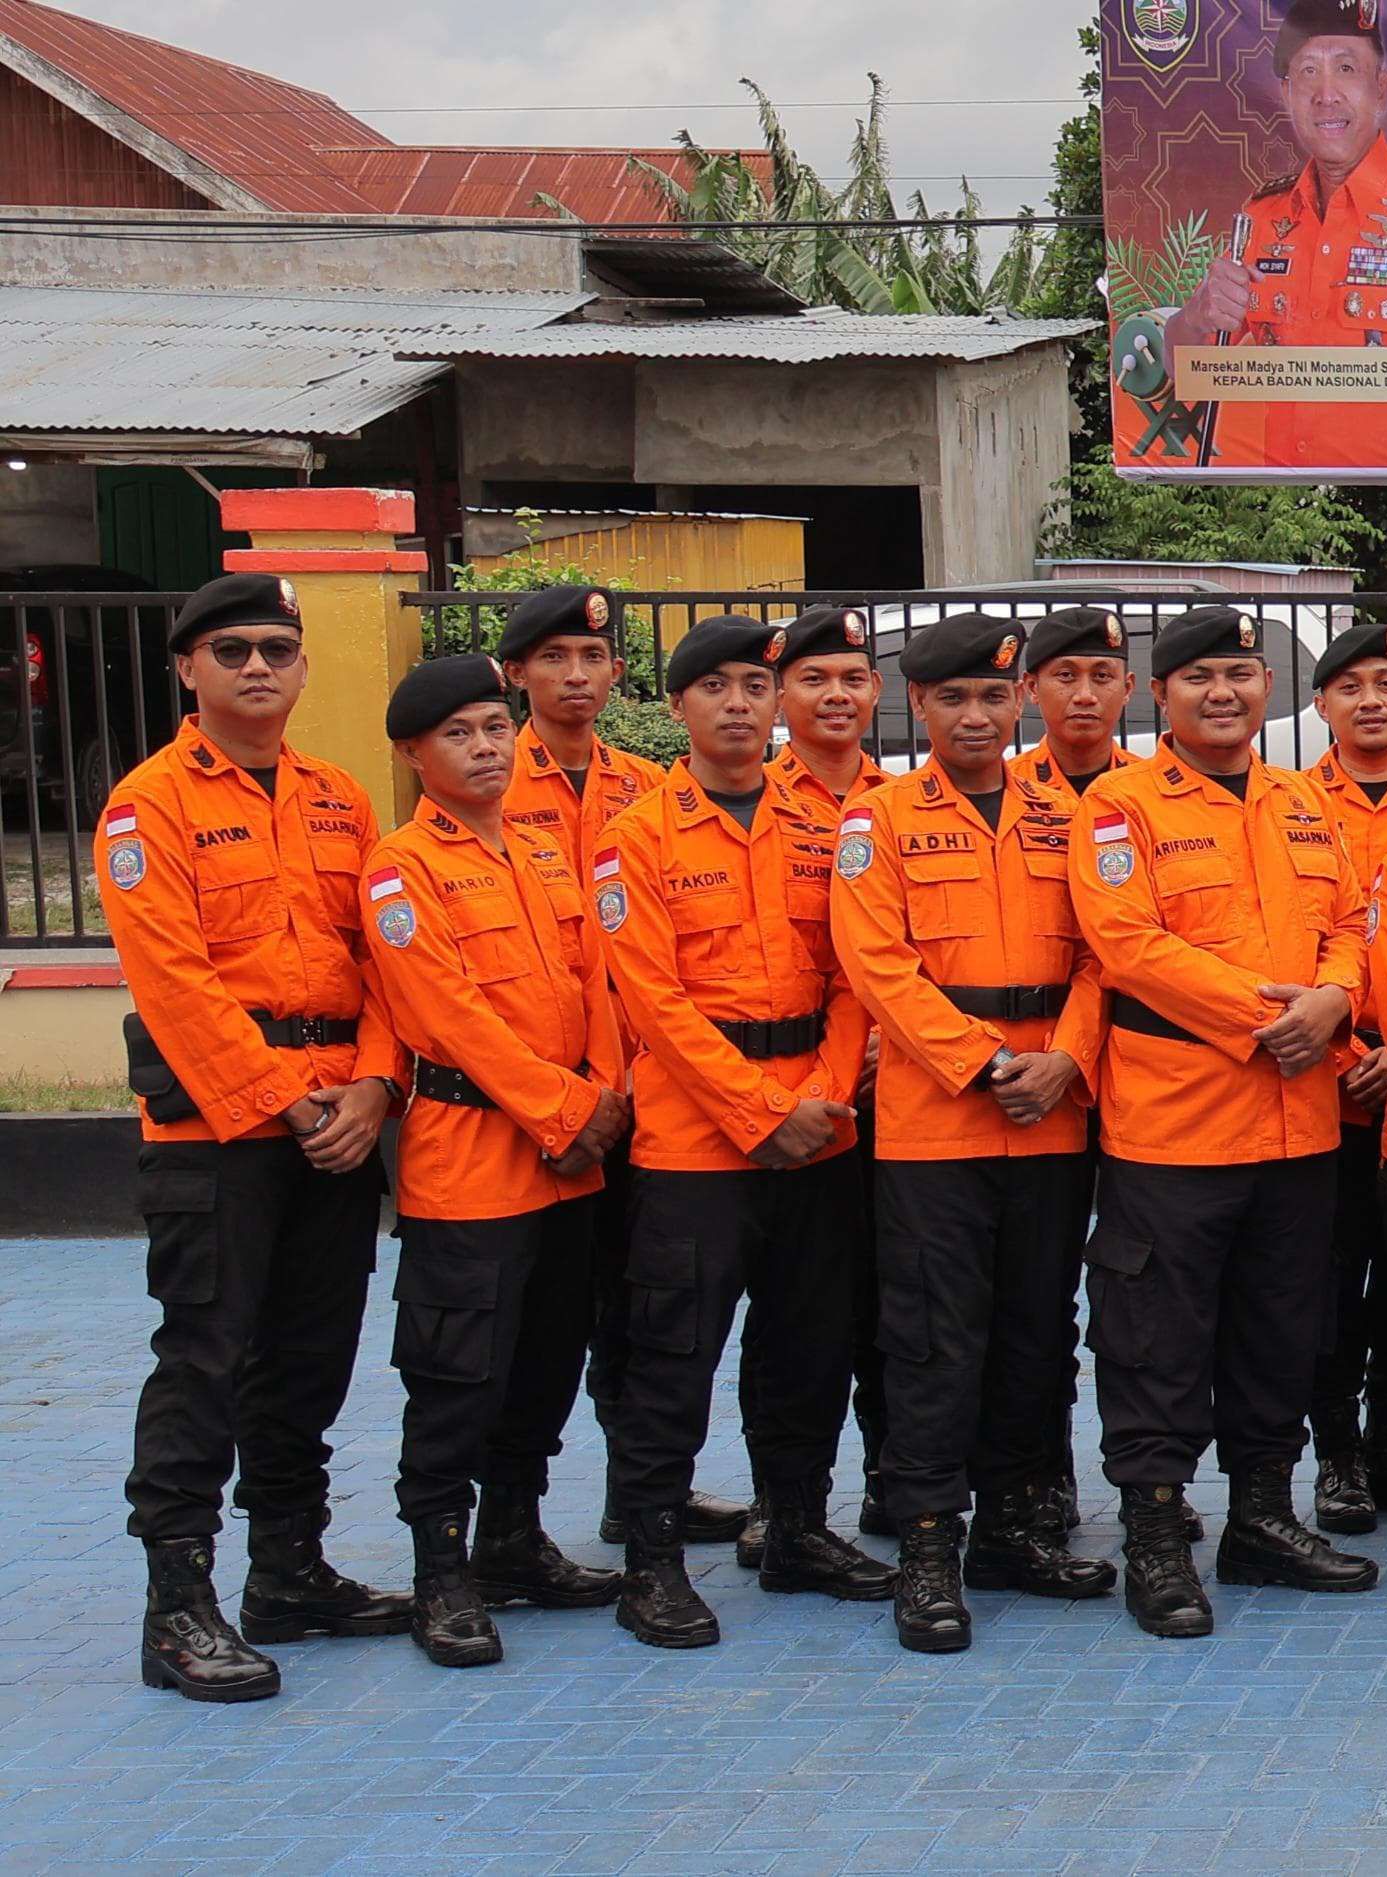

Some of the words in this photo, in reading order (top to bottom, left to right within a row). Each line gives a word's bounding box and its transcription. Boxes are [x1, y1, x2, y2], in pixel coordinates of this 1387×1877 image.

[1191, 360, 1243, 373] Marsekal
[1246, 361, 1284, 376] Madya
[1287, 362, 1308, 373] TNI
[1310, 362, 1378, 374] Mohammad
[1213, 375, 1265, 387] KEPALA
[1267, 376, 1313, 387] BADAN
[1315, 376, 1381, 388] NASIONAL
[910, 833, 969, 850] ADHI
[1155, 837, 1217, 859] ARIFUDDIN
[443, 876, 495, 894] MARIO
[668, 872, 729, 891] TAKDIR
